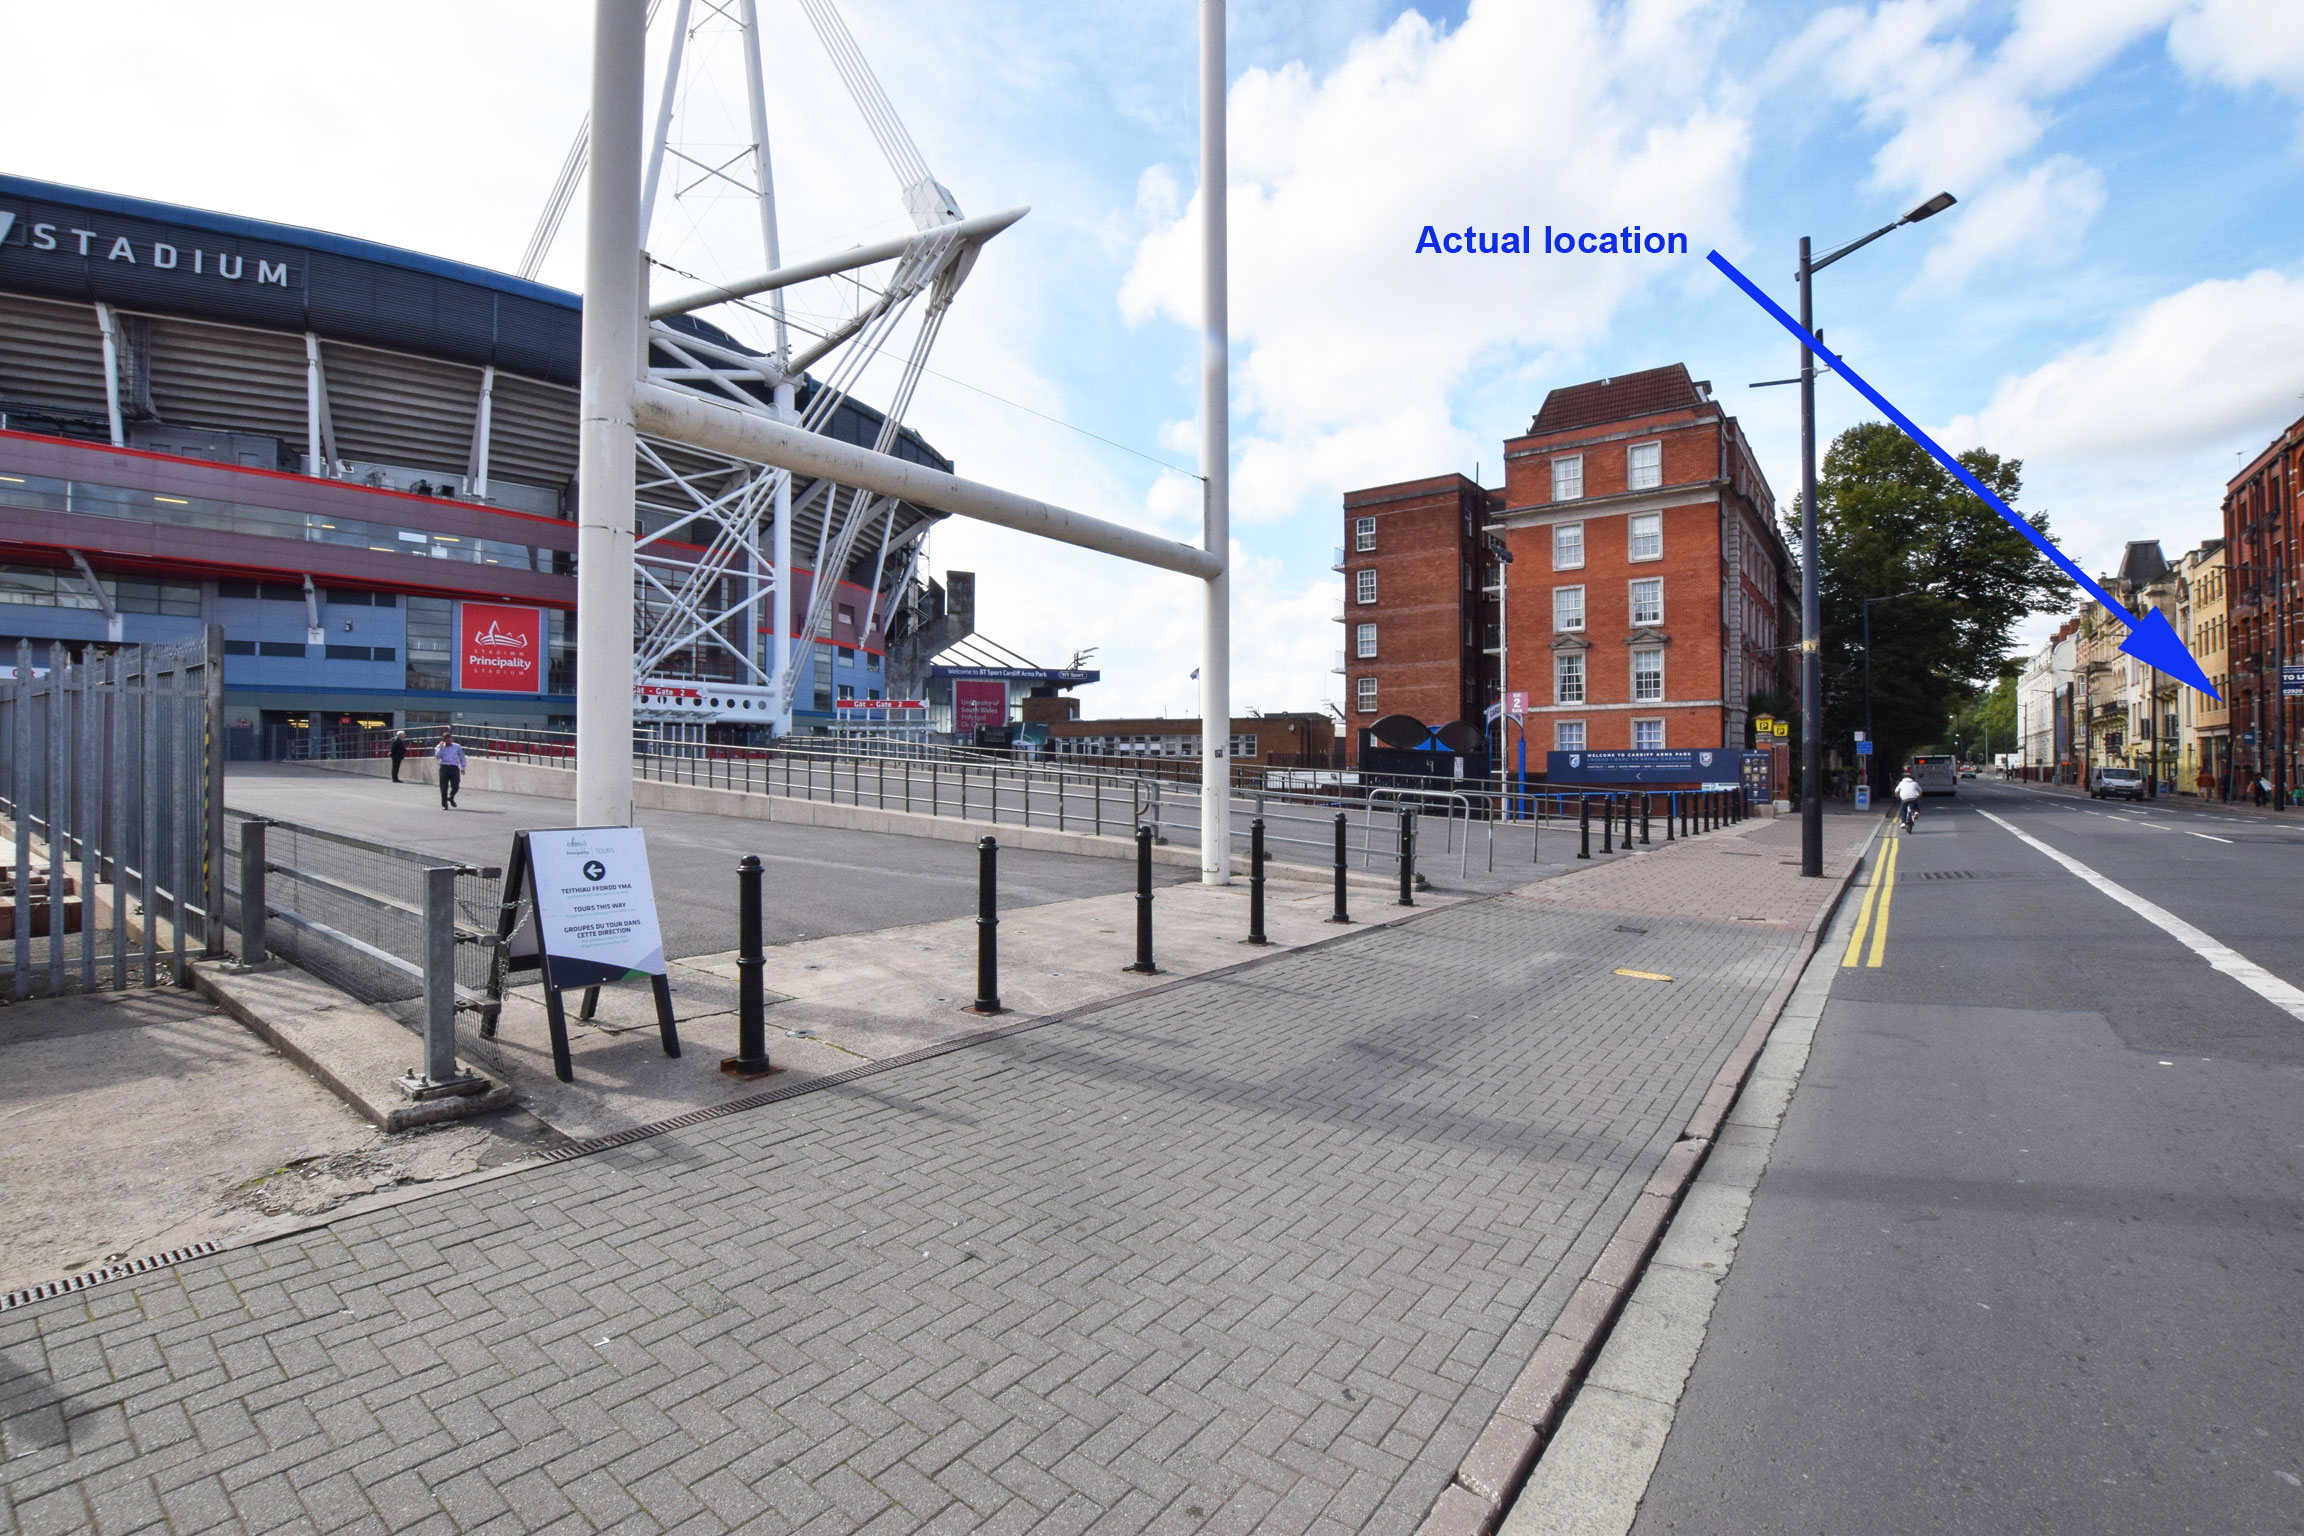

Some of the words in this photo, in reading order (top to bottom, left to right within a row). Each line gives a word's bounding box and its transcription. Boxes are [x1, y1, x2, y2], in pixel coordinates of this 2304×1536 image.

[33, 223, 288, 287] STADIUM
[469, 655, 532, 670] Principality
[987, 669, 1003, 677] Sport
[1003, 669, 1020, 677] Cardiff
[656, 687, 674, 696] Gate
[680, 689, 686, 697] 2
[1513, 698, 1521, 708] 2
[561, 886, 591, 894] TEITHIAU
[592, 884, 617, 892] FFORDD
[564, 924, 595, 933] GROUPES
[598, 927, 631, 936] DIRECTION
